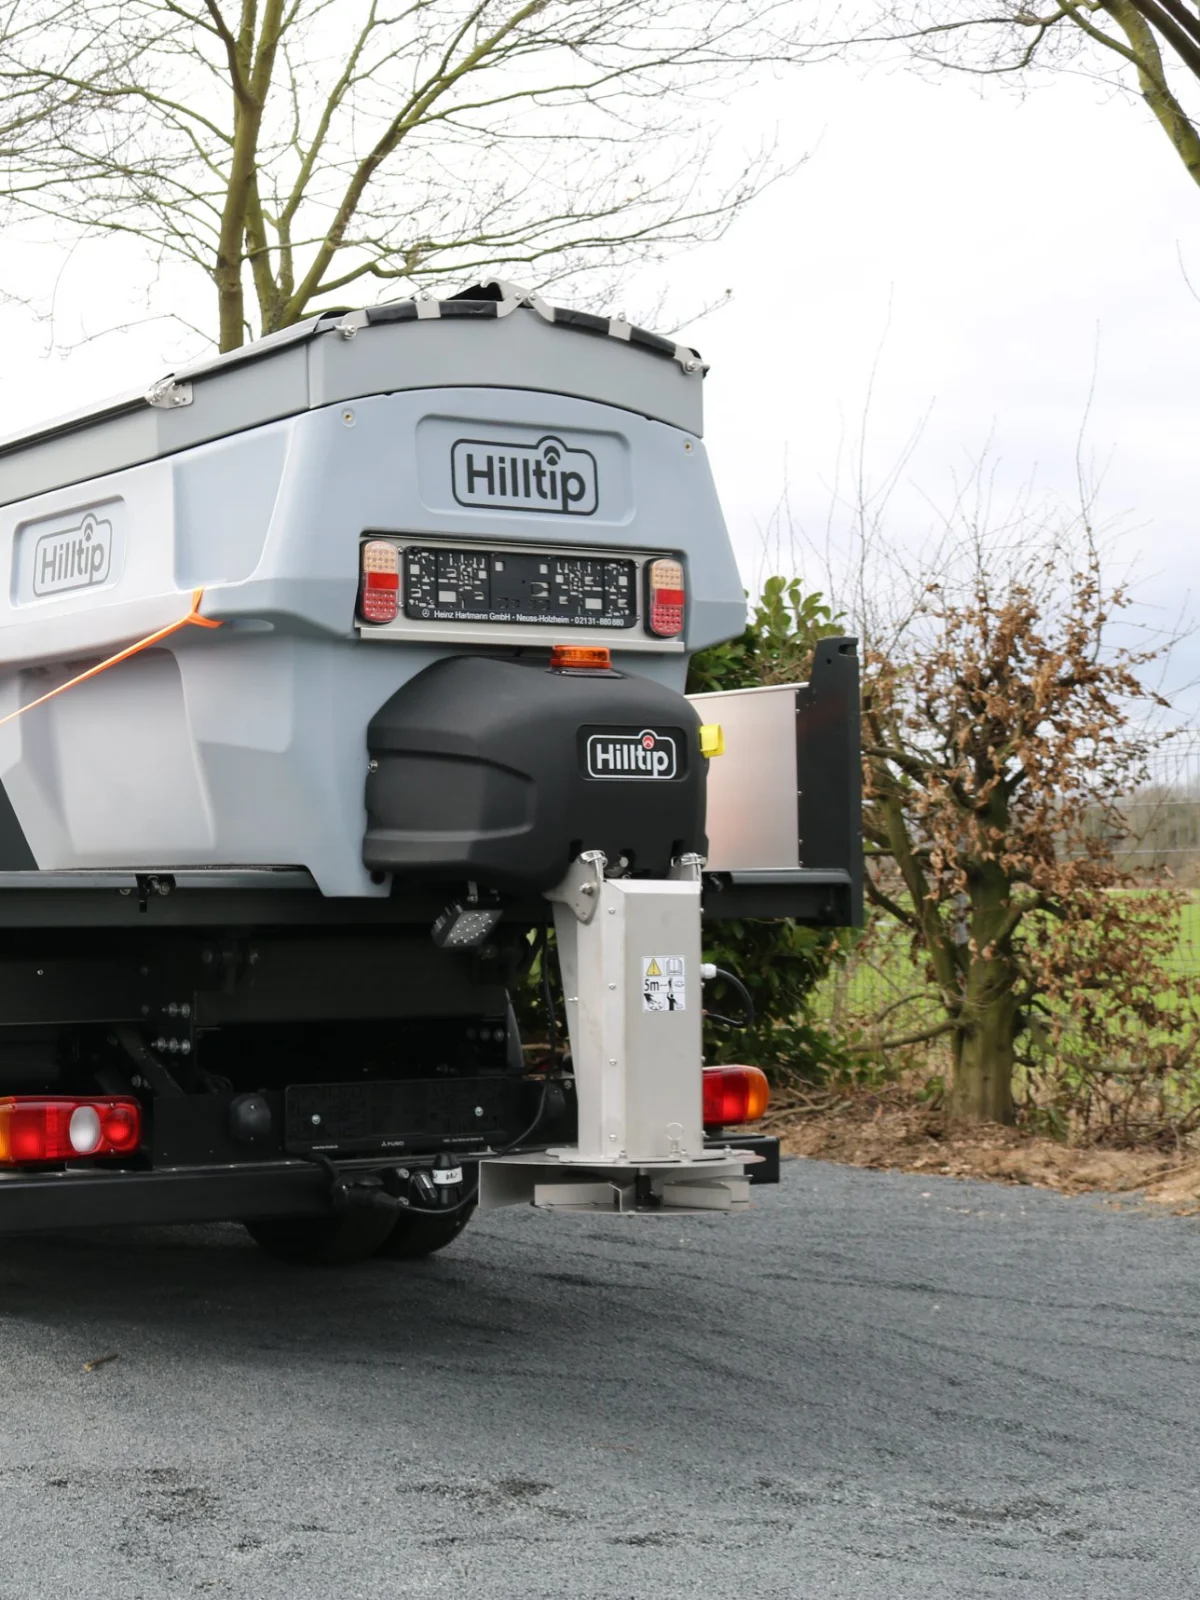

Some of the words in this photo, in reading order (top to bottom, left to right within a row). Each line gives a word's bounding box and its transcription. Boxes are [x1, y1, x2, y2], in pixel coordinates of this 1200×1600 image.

[466, 446, 586, 513] Hilltip
[41, 524, 105, 584] Hilltip
[434, 610, 454, 619] Heinz
[455, 611, 488, 620] Hartmann
[489, 612, 511, 621] GmbH
[596, 735, 669, 777] Hilltip
[644, 978, 660, 992] 5m
